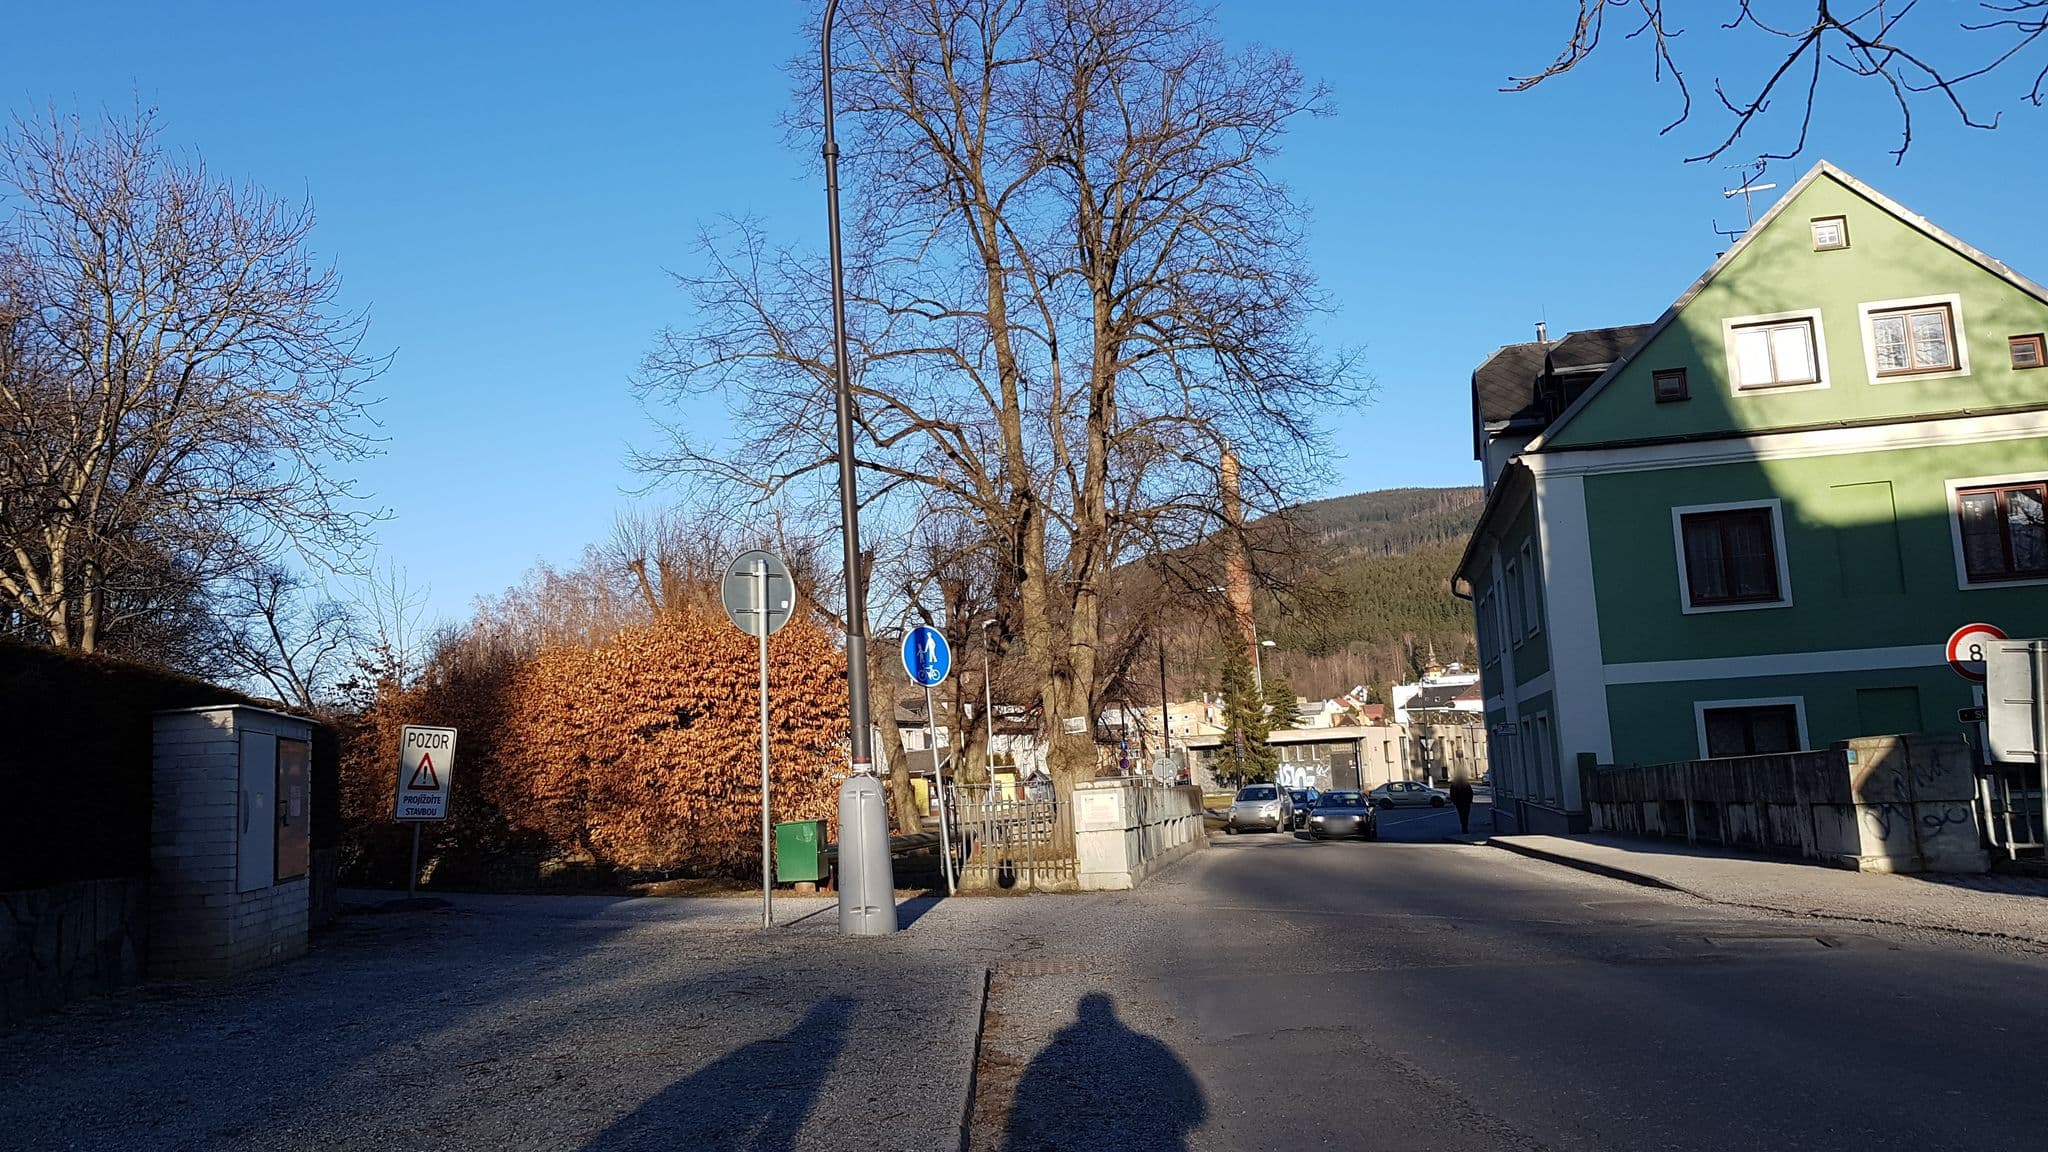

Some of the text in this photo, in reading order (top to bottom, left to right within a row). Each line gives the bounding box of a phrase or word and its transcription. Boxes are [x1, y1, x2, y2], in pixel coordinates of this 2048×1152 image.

[1969, 643, 1983, 662] 8
[407, 732, 450, 750] POZOR
[405, 807, 437, 816] STAVBOU
